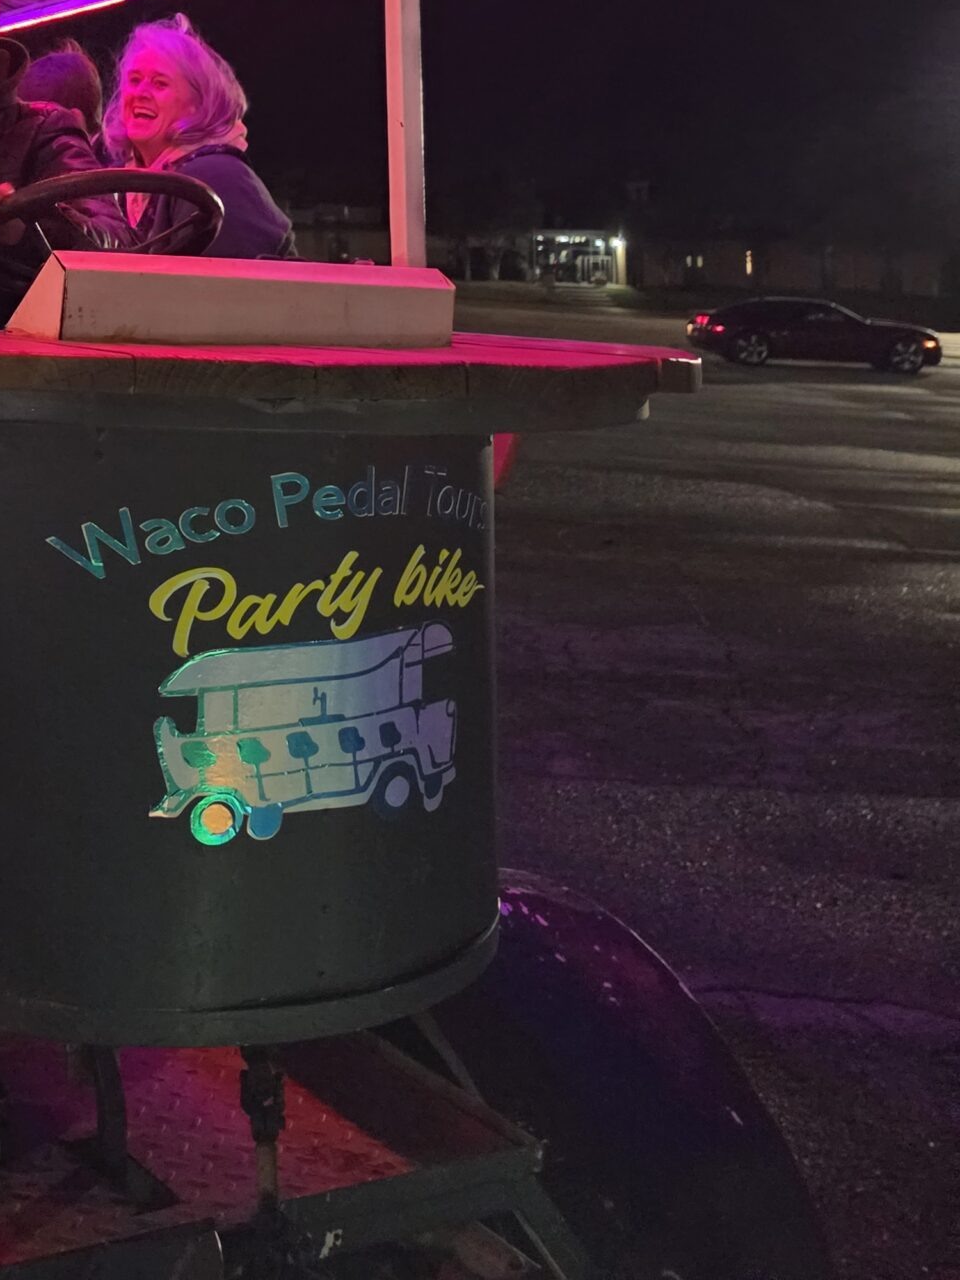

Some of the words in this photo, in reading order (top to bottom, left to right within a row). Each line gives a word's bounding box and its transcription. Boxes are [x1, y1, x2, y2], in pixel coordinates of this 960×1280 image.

[45, 498, 256, 580] Waco
[270, 465, 408, 528] Pedal
[148, 551, 383, 657] Party
[394, 544, 485, 608] bike
